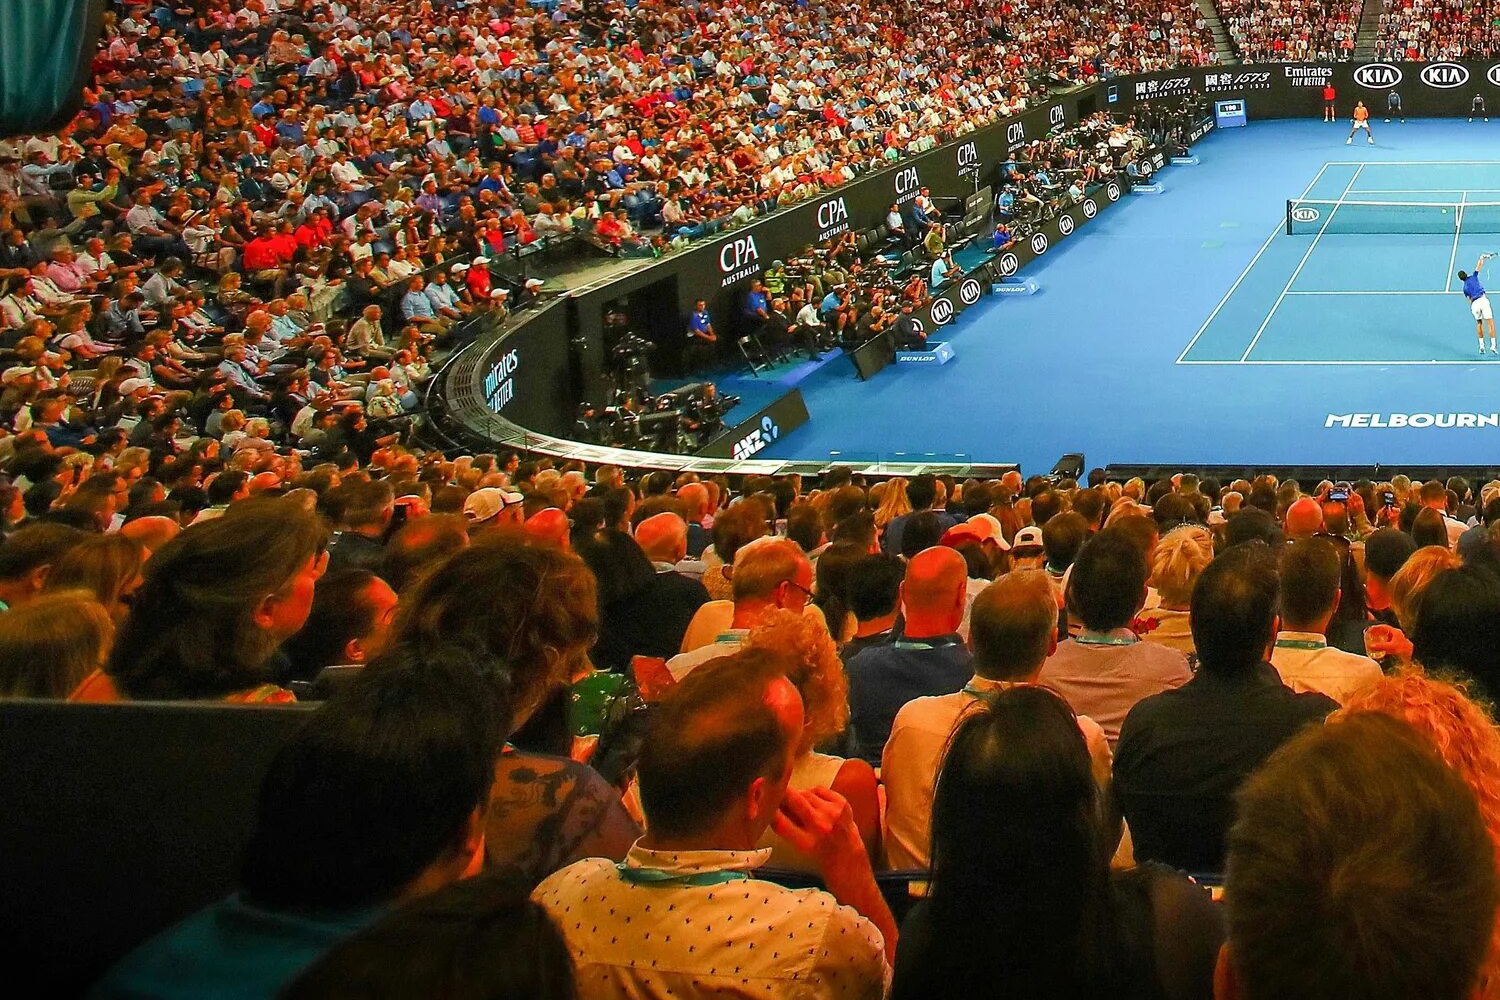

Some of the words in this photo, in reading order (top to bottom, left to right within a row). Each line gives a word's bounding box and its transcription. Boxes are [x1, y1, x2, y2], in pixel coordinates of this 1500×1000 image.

[1284, 66, 1333, 77] Emirates
[1361, 69, 1395, 83] KIA
[1428, 69, 1463, 83] KIA
[1050, 104, 1064, 126] CPA
[1007, 121, 1025, 144] CPA
[957, 141, 978, 167] CPA
[895, 166, 919, 195] CPA
[817, 196, 849, 230] CPA
[818, 222, 849, 242] AUSTRALIA
[1033, 235, 1047, 251] KIA
[720, 235, 760, 273] CPA
[1002, 256, 1017, 273] KIA
[721, 264, 760, 288] AUSTRALIA
[962, 281, 979, 300] KIA
[933, 302, 951, 322] KIA
[733, 428, 766, 460] ANZ
